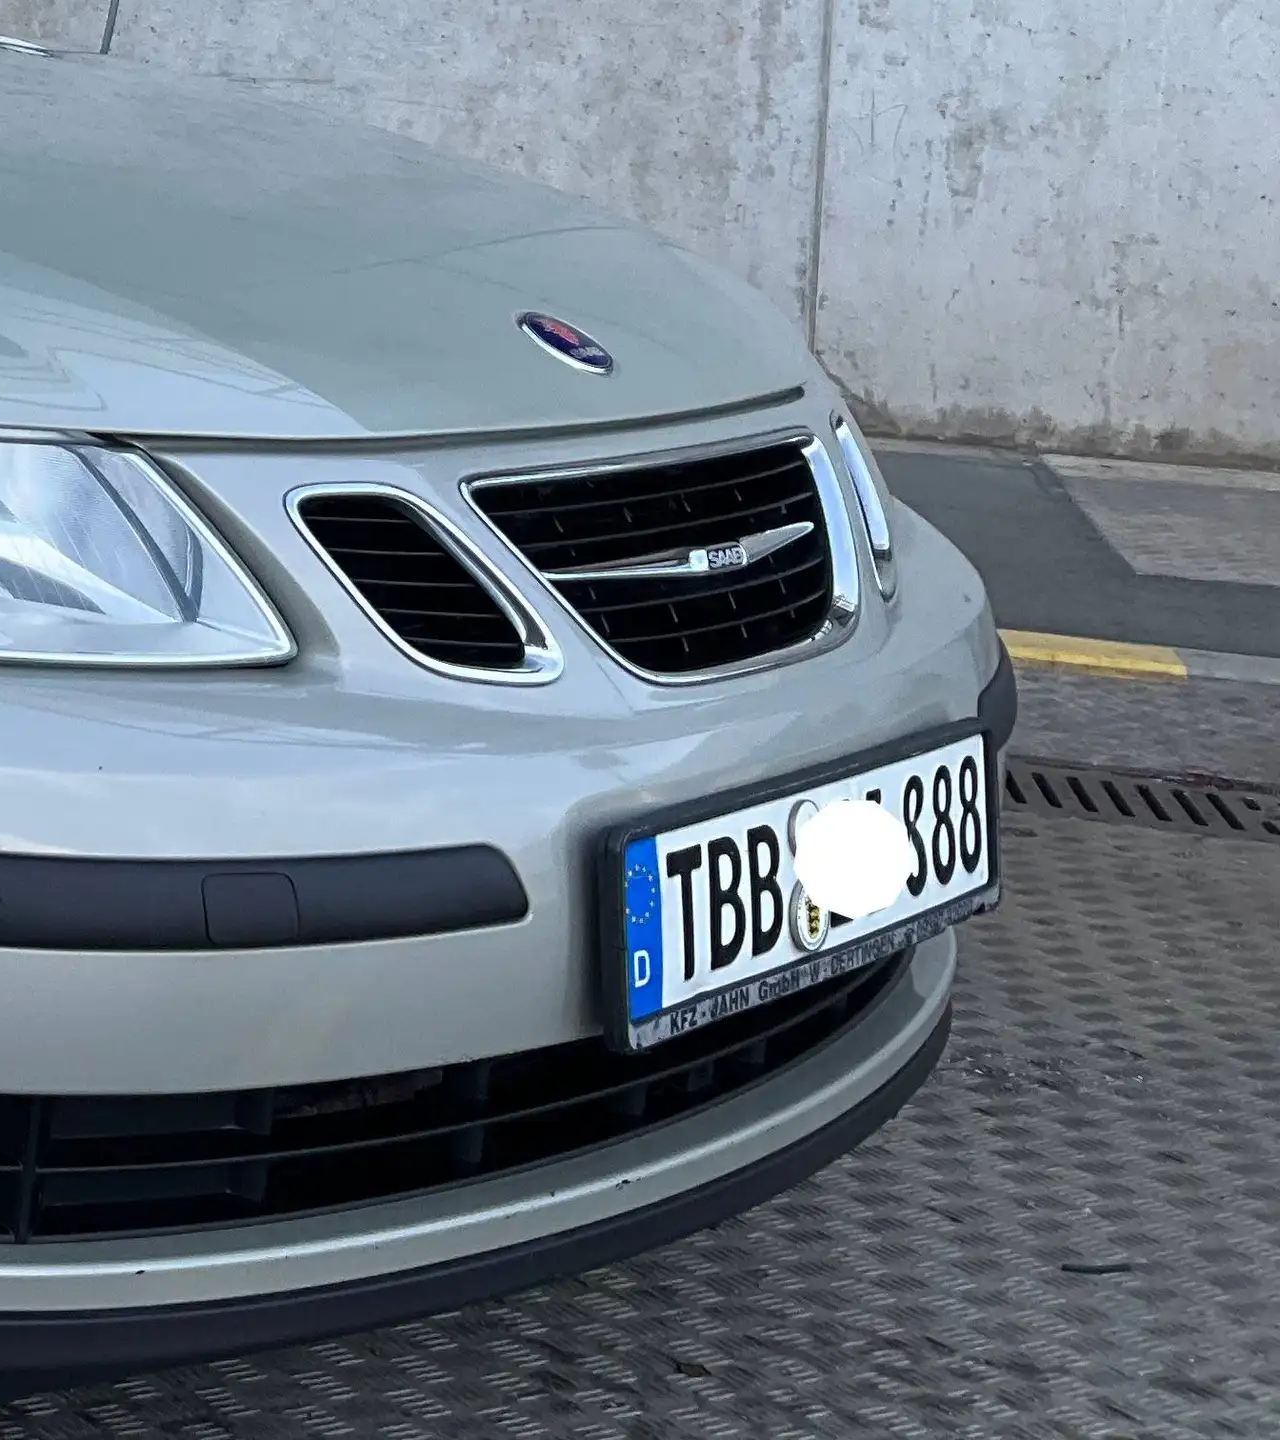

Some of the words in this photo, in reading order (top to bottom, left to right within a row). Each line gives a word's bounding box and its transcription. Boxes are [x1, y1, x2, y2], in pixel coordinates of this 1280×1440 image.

[708, 546, 744, 568] SAAB
[666, 824, 783, 982] TBB
[633, 949, 651, 988] D
